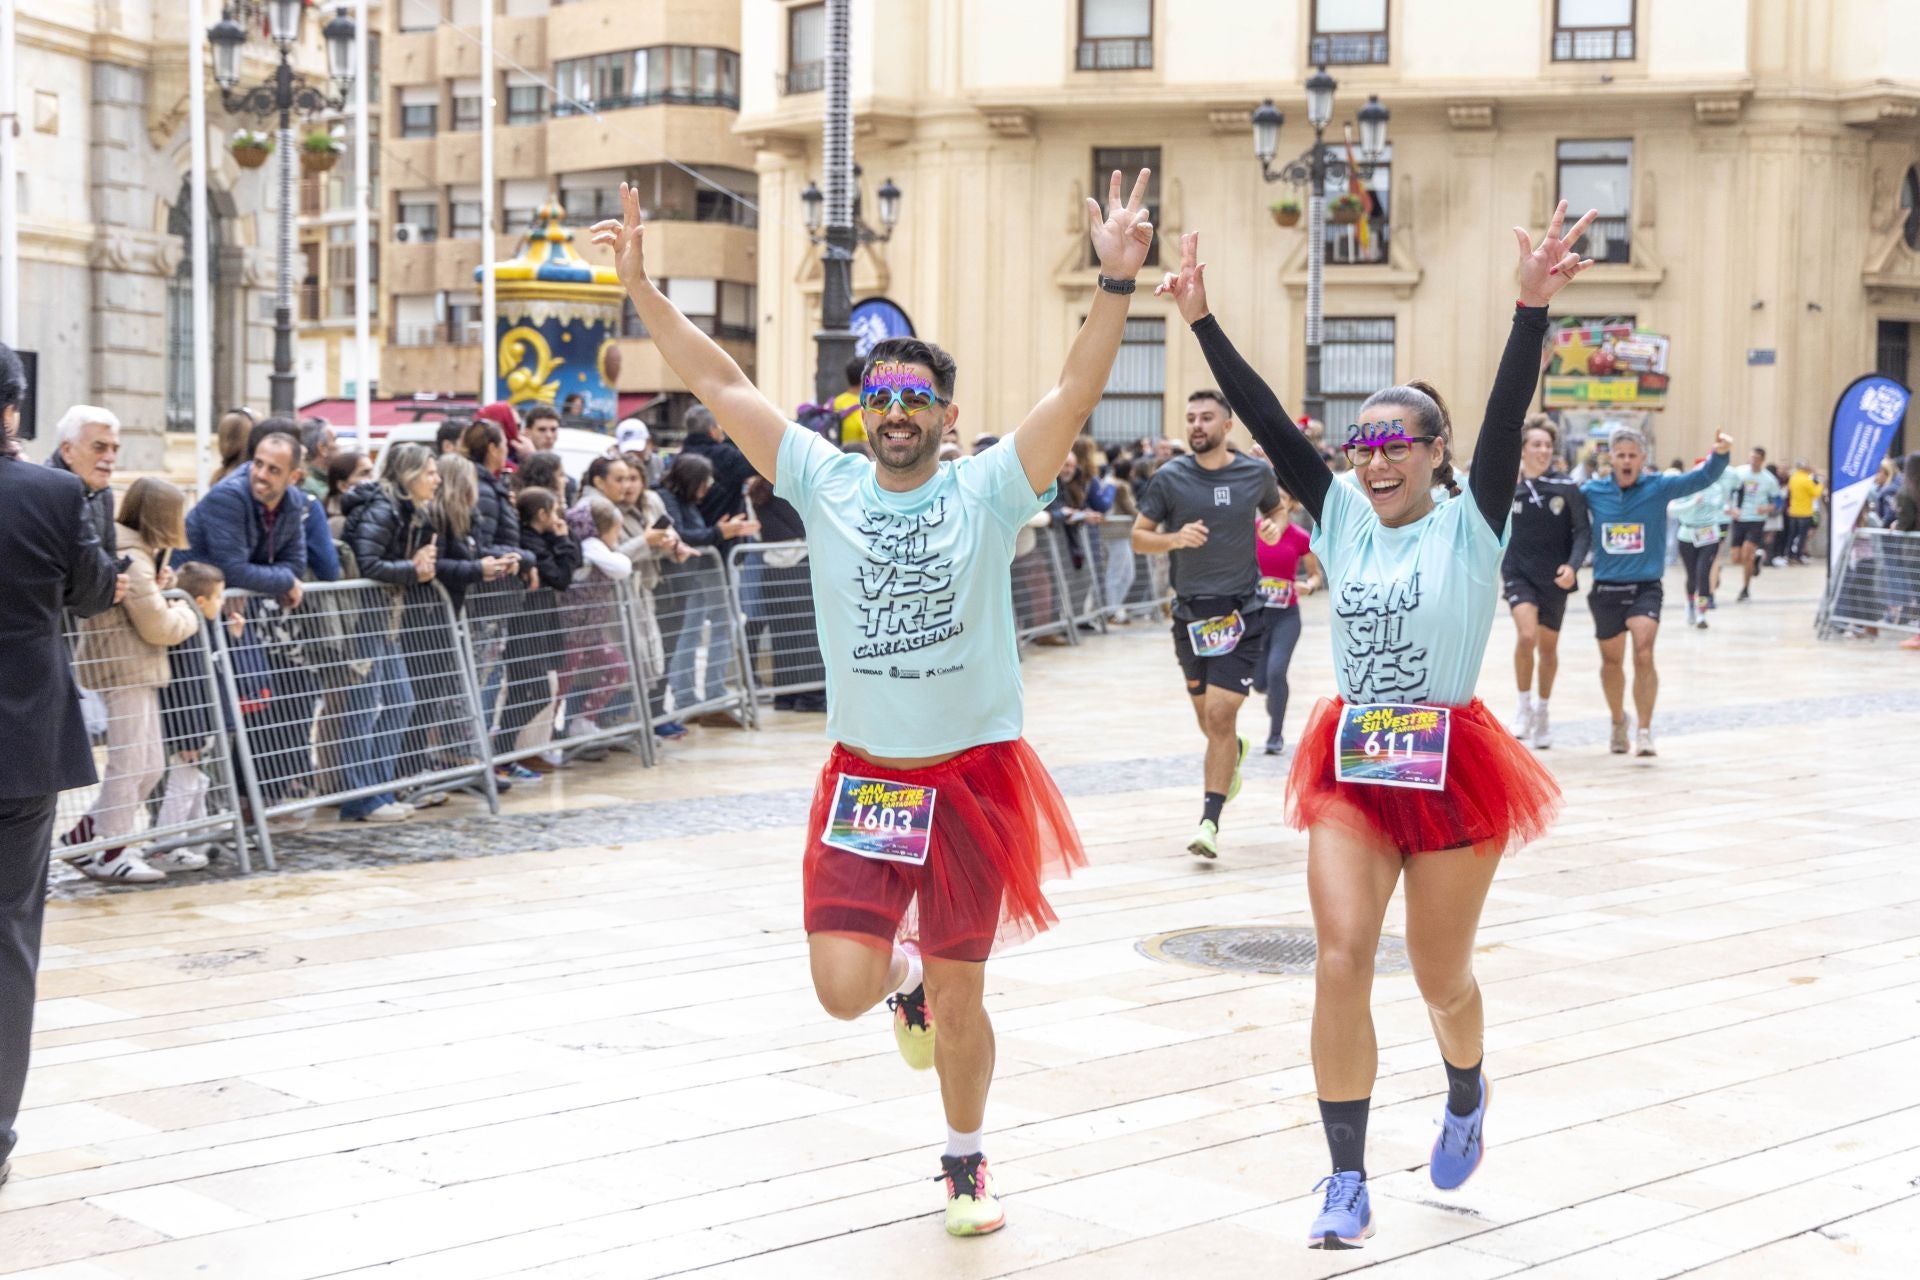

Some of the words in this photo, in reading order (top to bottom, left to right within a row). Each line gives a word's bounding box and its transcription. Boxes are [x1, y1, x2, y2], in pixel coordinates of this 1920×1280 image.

[875, 360, 915, 375] Feliz
[1347, 419, 1405, 443] 2025
[858, 496, 946, 541] SAN
[853, 558, 953, 601] VES
[1336, 573, 1421, 618] SAN
[857, 592, 956, 638] TRE
[853, 621, 964, 659] CARTAGENA
[1345, 616, 1413, 658] SIL
[1343, 647, 1427, 694] VES
[1361, 711, 1439, 733] SILVESTRE
[1363, 708, 1394, 721] SAN
[1364, 731, 1414, 759] 611
[857, 788, 925, 806] SILVESTRE
[860, 783, 885, 795] SAN
[852, 802, 913, 835] 1603
